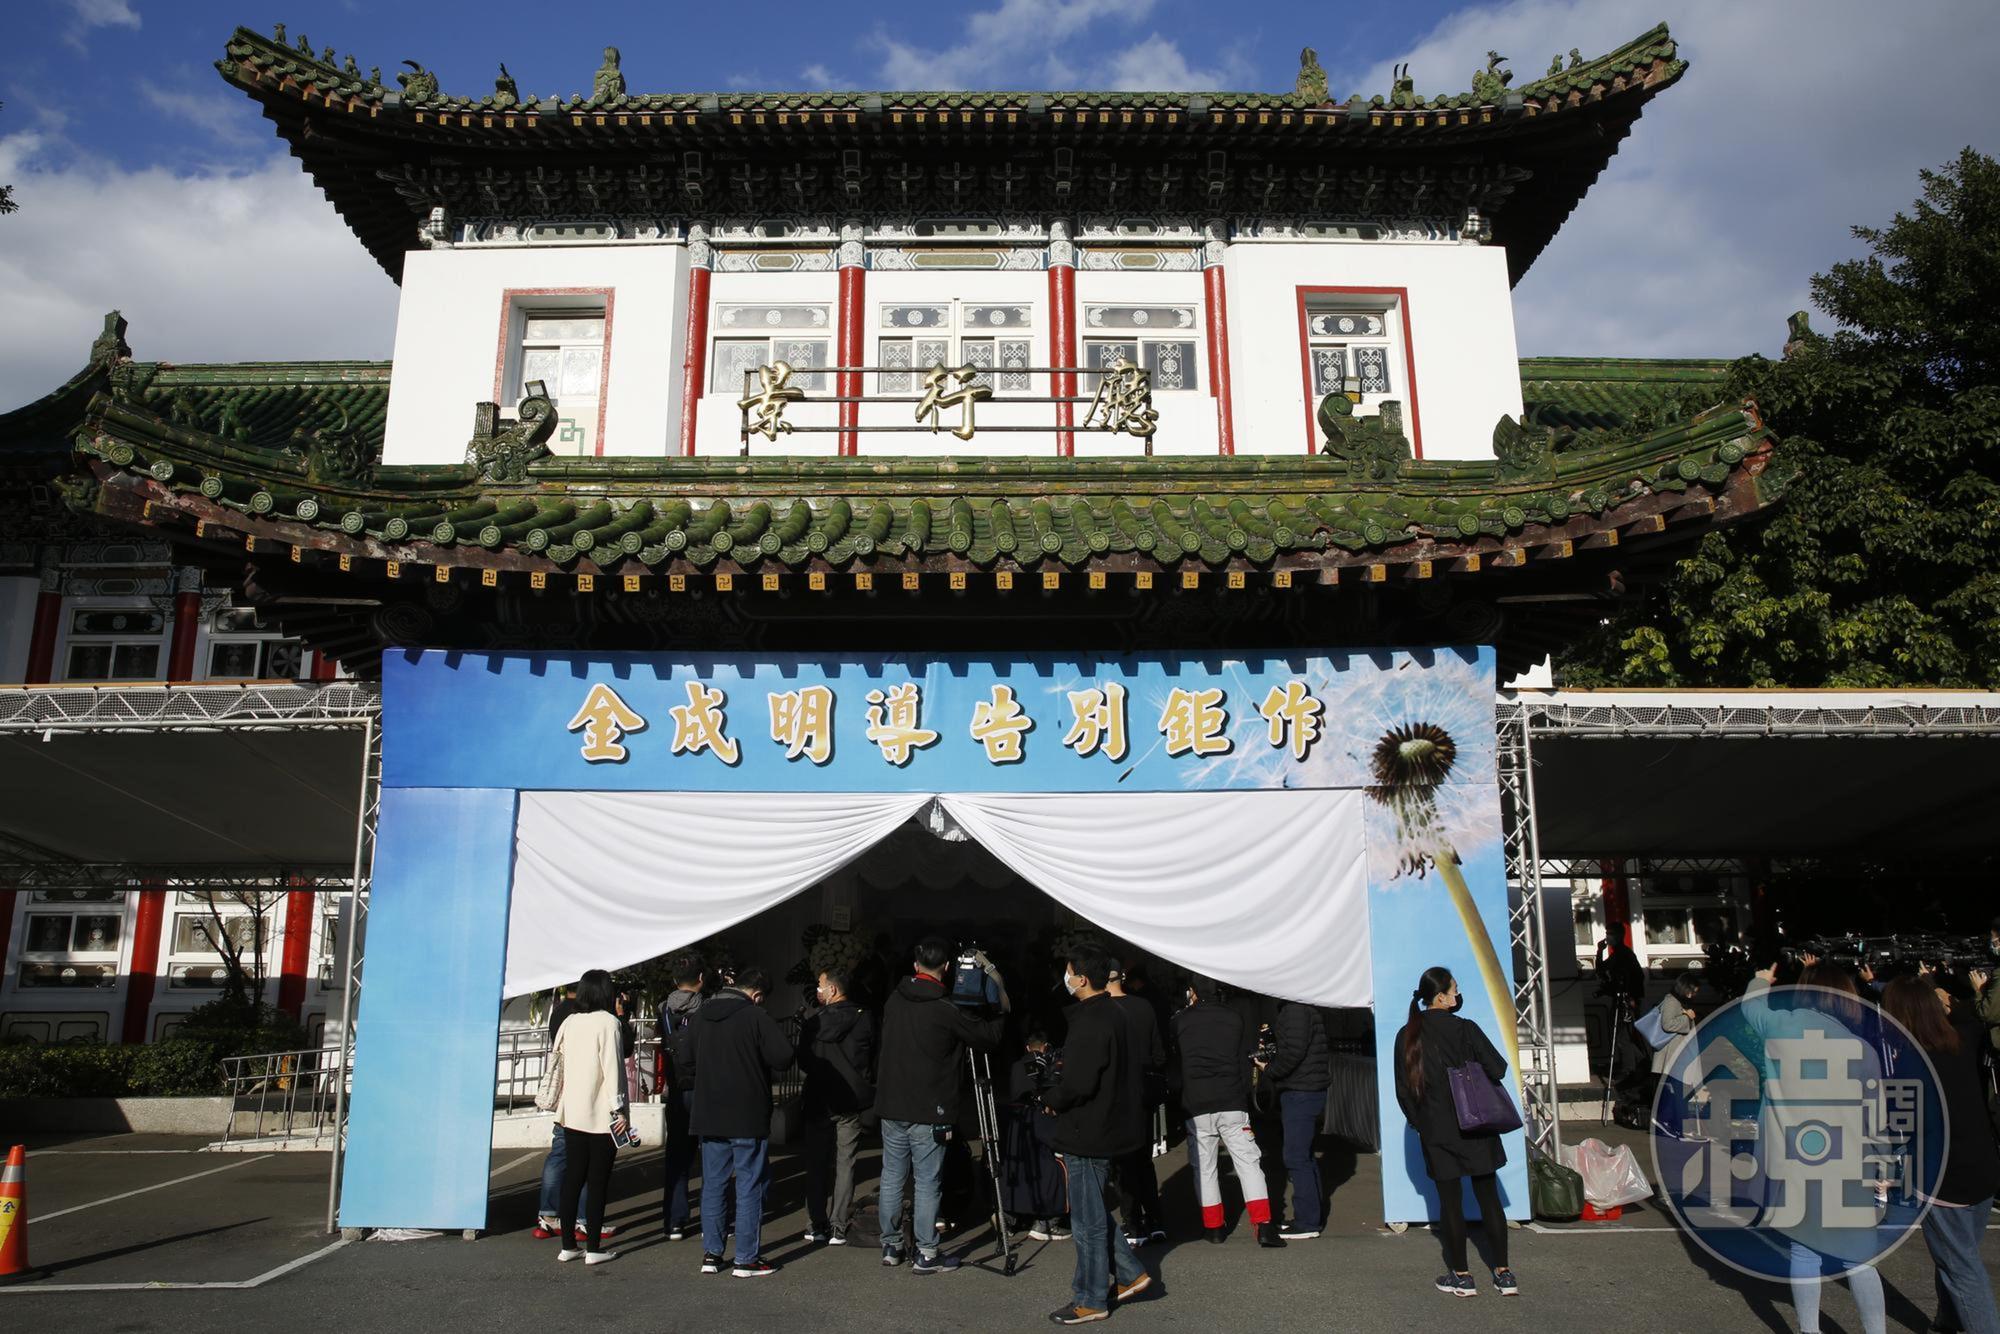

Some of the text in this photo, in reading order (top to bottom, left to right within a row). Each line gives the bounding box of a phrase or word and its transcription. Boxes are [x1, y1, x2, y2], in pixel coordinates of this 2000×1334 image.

[567, 679, 1326, 766] 金成明導告別鉅作
